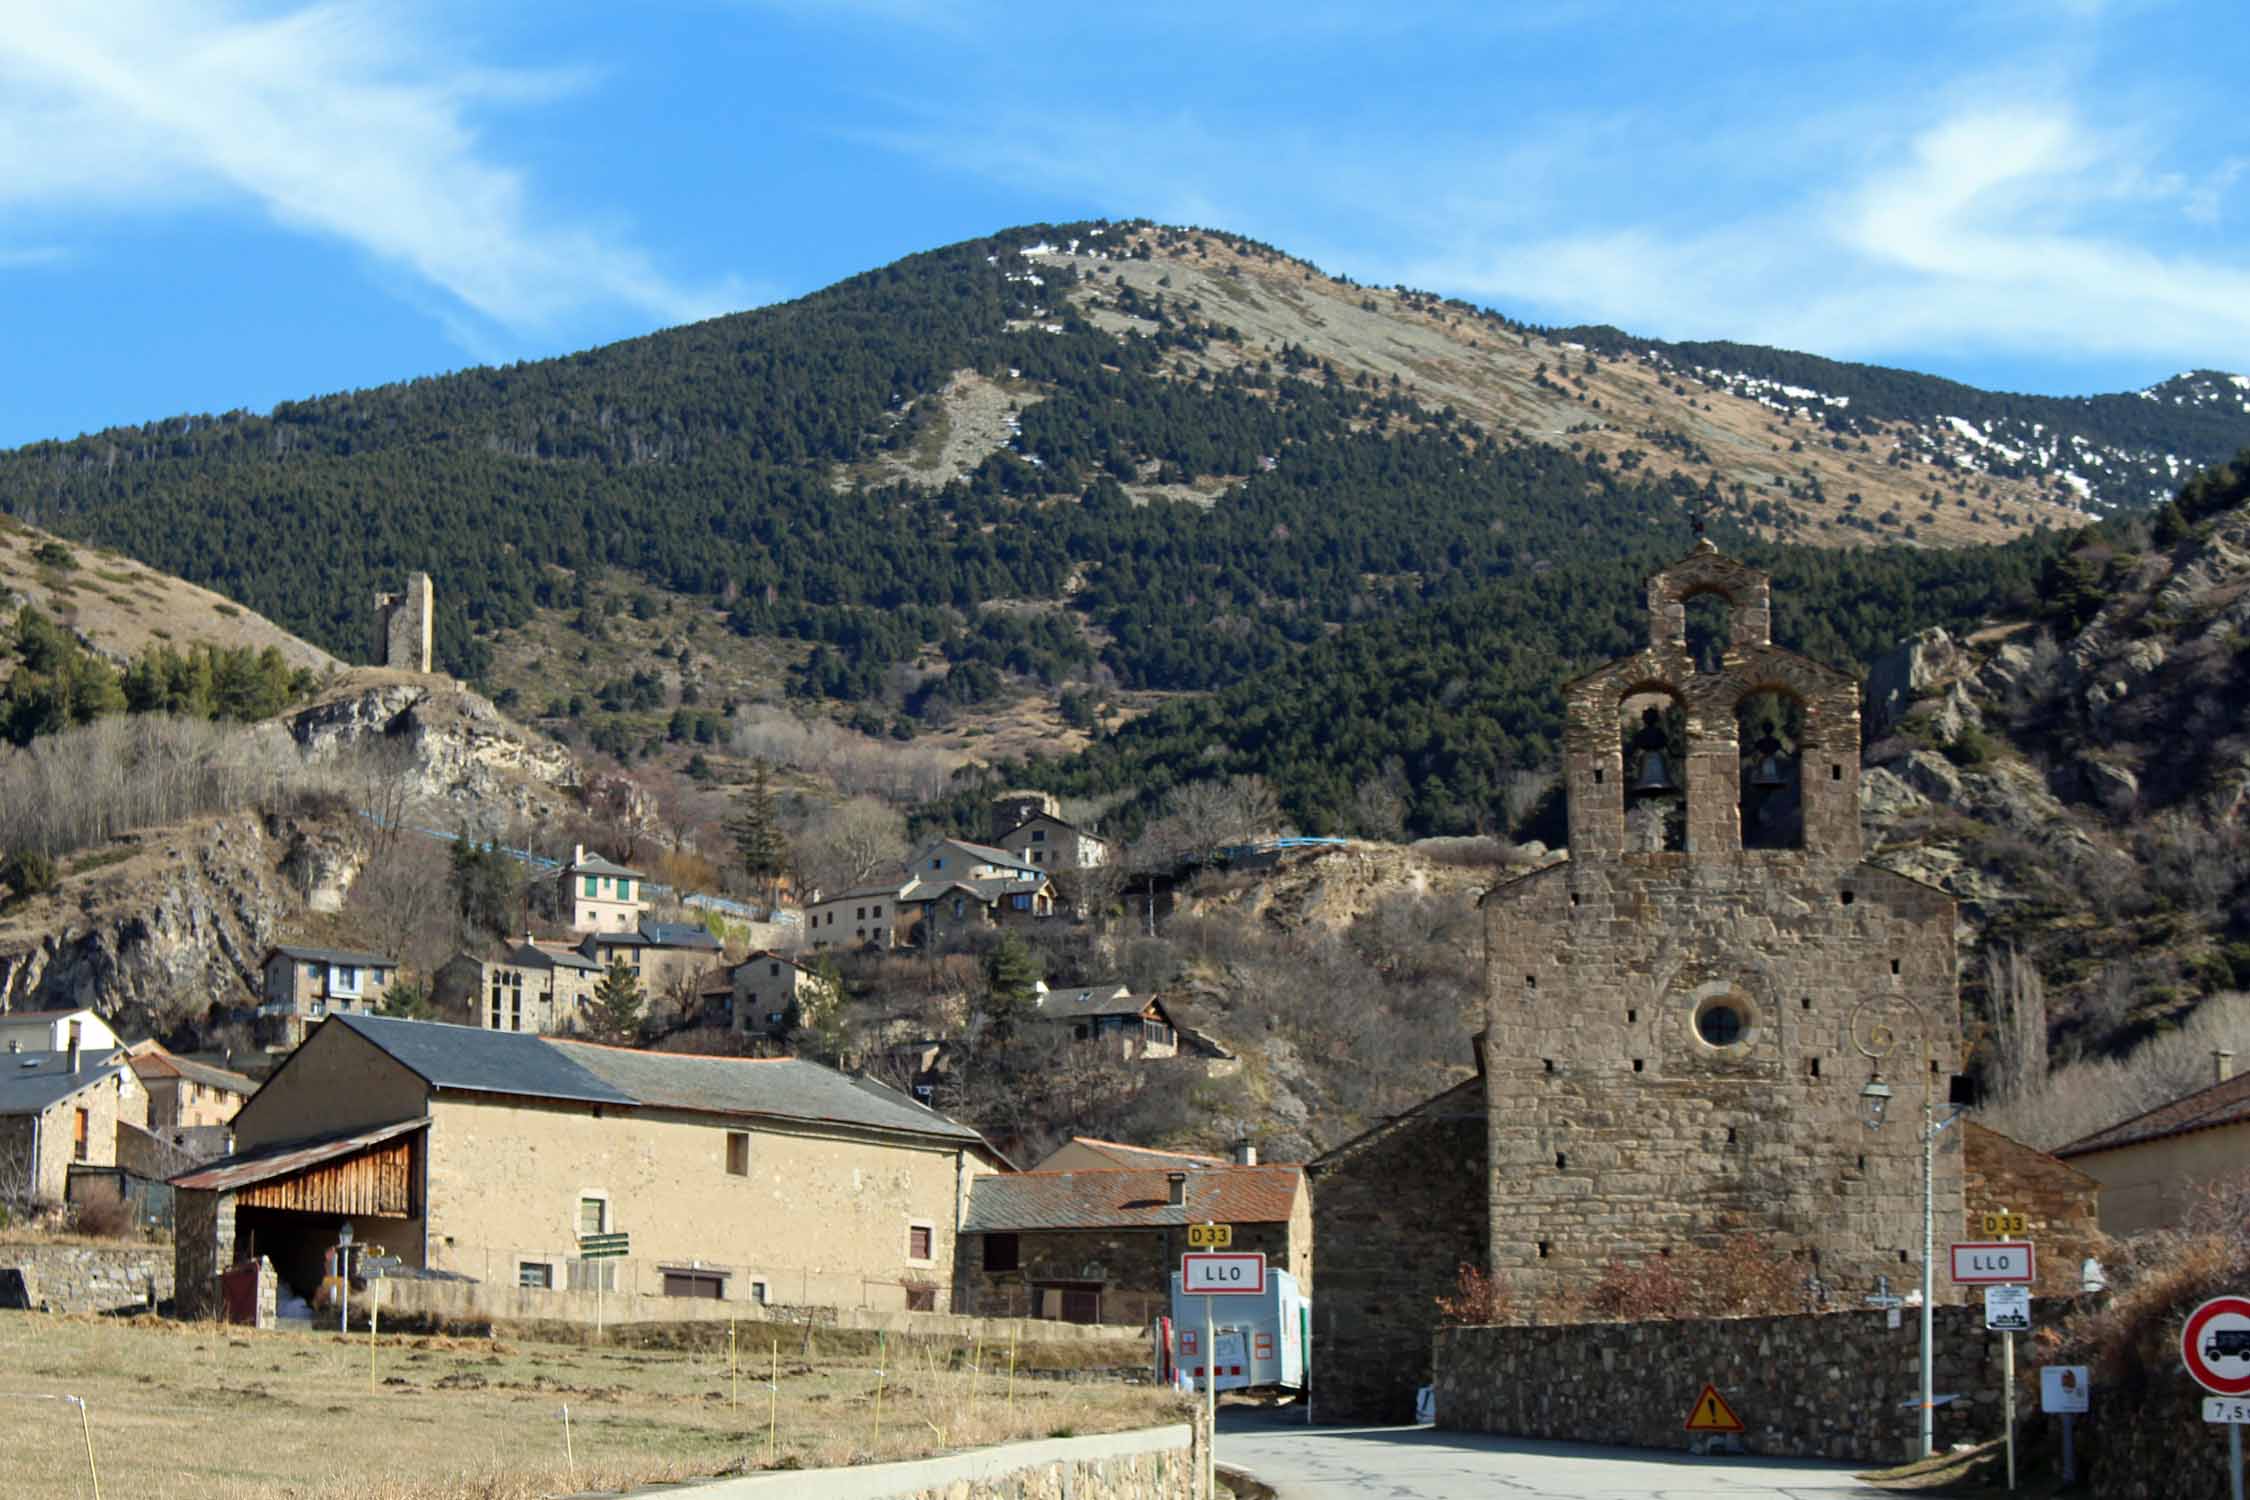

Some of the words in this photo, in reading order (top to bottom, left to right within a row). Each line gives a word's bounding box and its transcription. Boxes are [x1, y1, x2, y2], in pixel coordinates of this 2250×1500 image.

[1986, 1217, 1998, 1232] D
[2002, 1217, 2022, 1231] 33
[1191, 1228, 1202, 1242] D
[1207, 1228, 1227, 1242] 33
[1973, 1255, 2010, 1271] LLO
[1205, 1265, 1241, 1281] LLO
